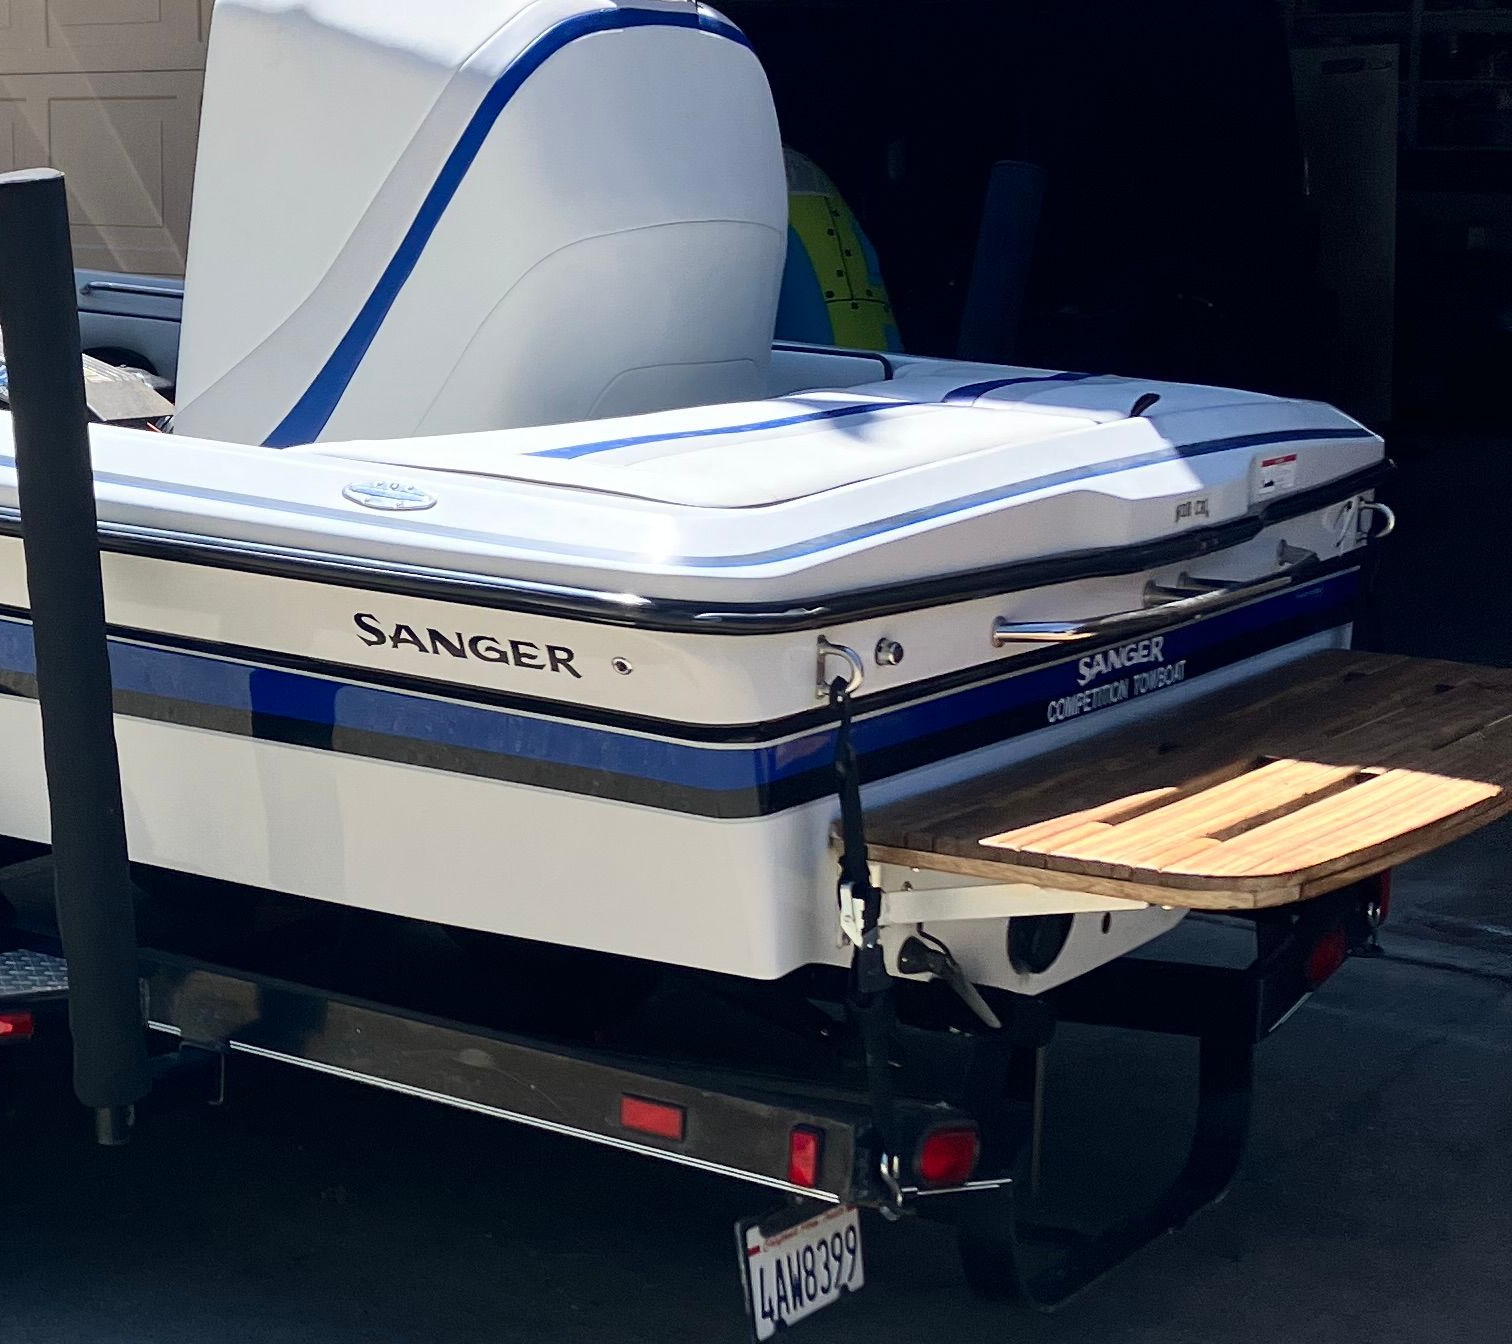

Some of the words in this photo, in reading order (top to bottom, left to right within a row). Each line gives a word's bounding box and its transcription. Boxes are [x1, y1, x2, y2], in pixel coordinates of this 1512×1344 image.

[353, 612, 582, 679] SANGER
[1077, 636, 1165, 686] SANGER
[1047, 678, 1129, 723] COMPETITION
[1133, 659, 1187, 695] TOWBOAT
[759, 1223, 857, 1322] 4AW8399
